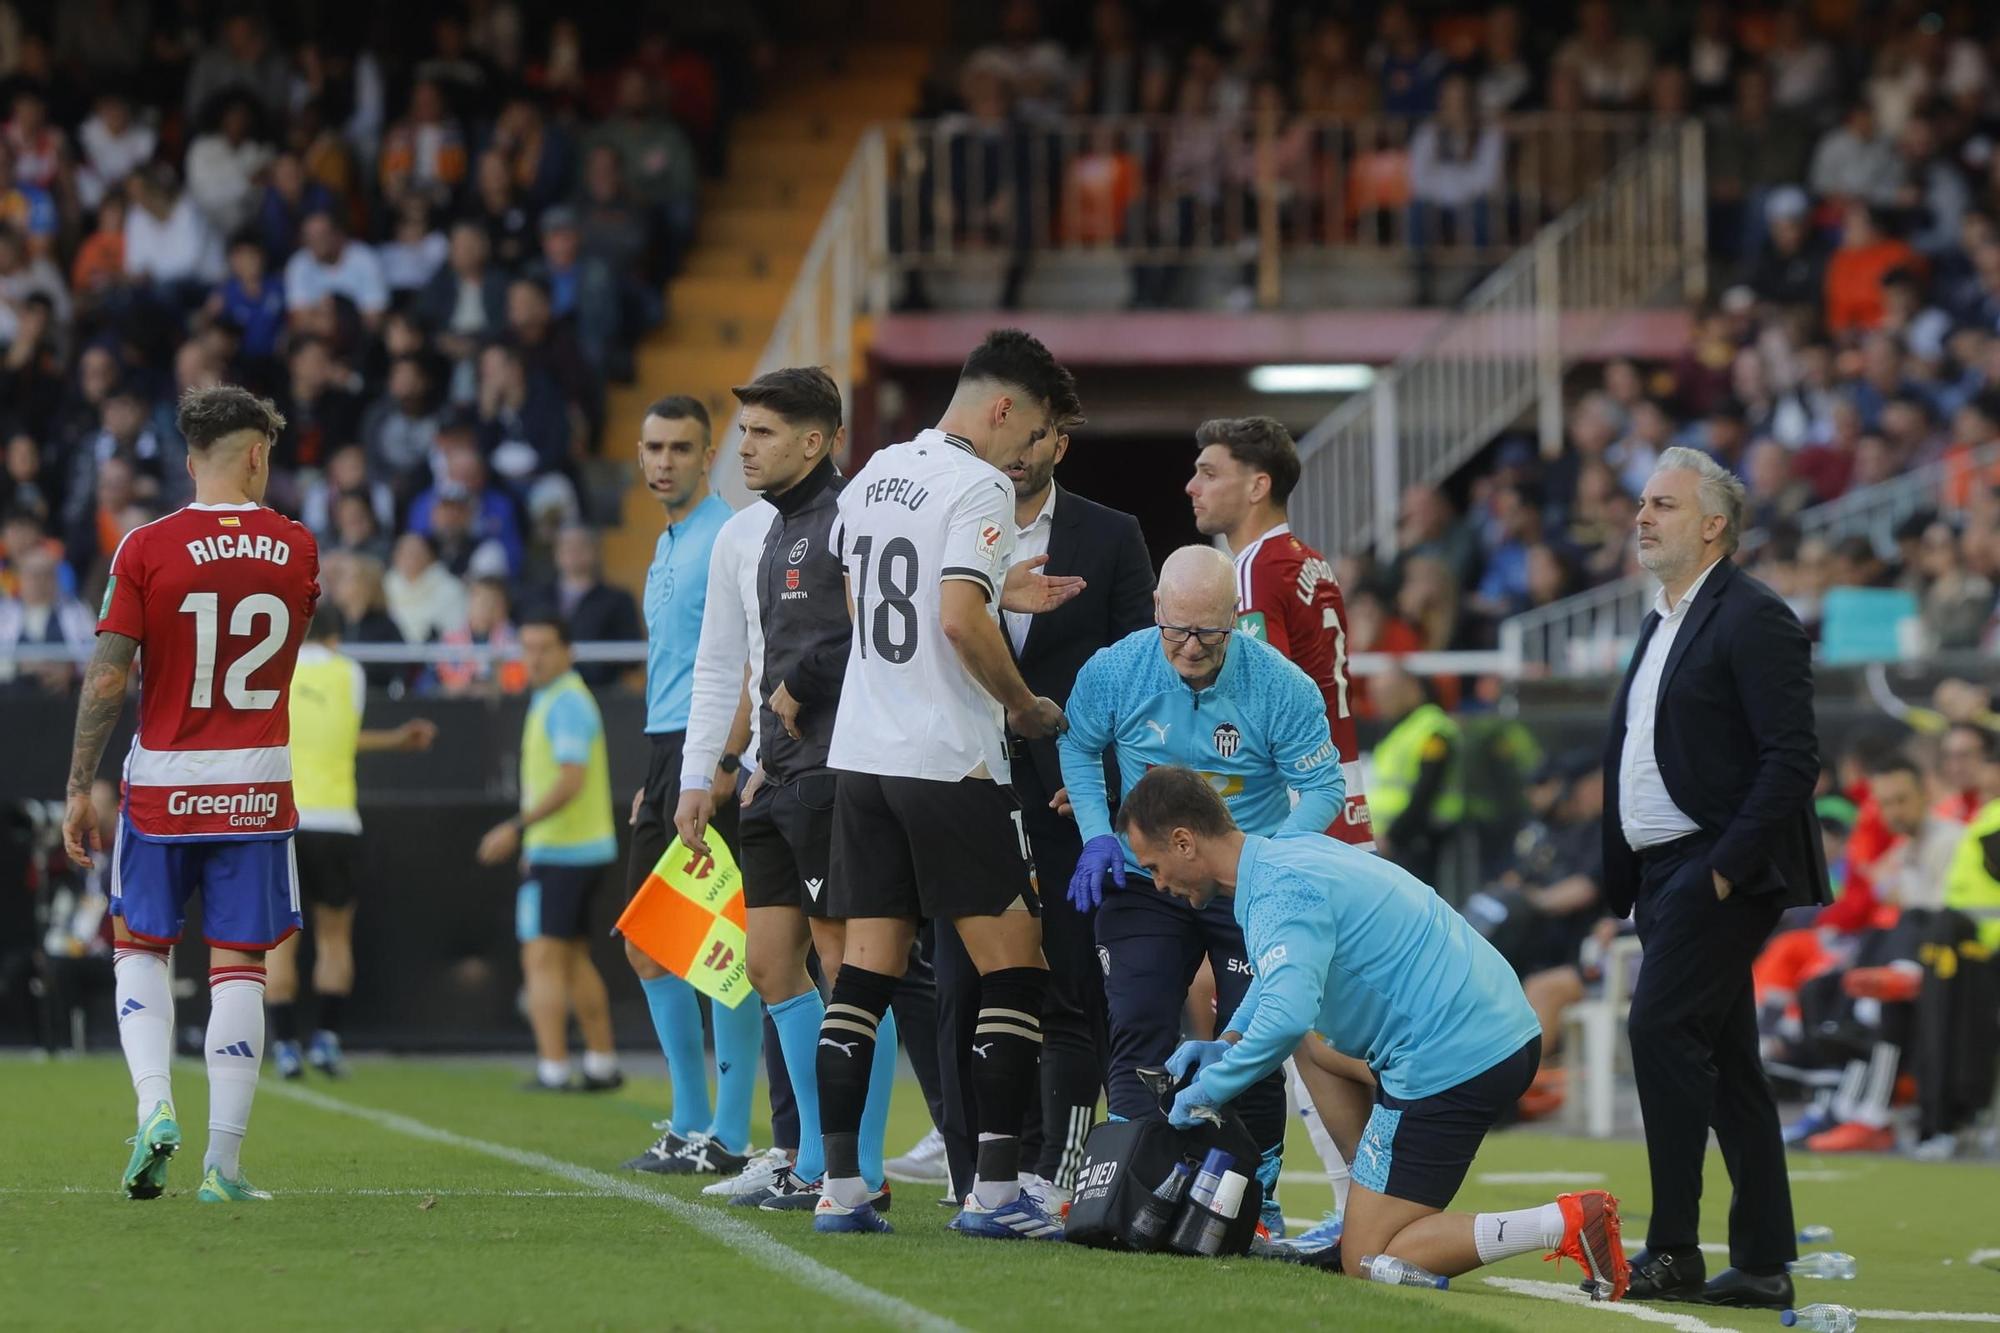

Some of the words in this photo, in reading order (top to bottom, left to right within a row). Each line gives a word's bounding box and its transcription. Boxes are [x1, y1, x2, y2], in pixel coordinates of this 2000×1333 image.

[866, 478, 929, 512] PEPELU
[186, 534, 290, 566] RICARD
[852, 535, 919, 664] 18
[178, 592, 290, 710] 12
[1294, 738, 1333, 772] divin
[168, 787, 278, 818] Greening
[229, 814, 267, 828] Group
[1010, 810, 1033, 860] 1
